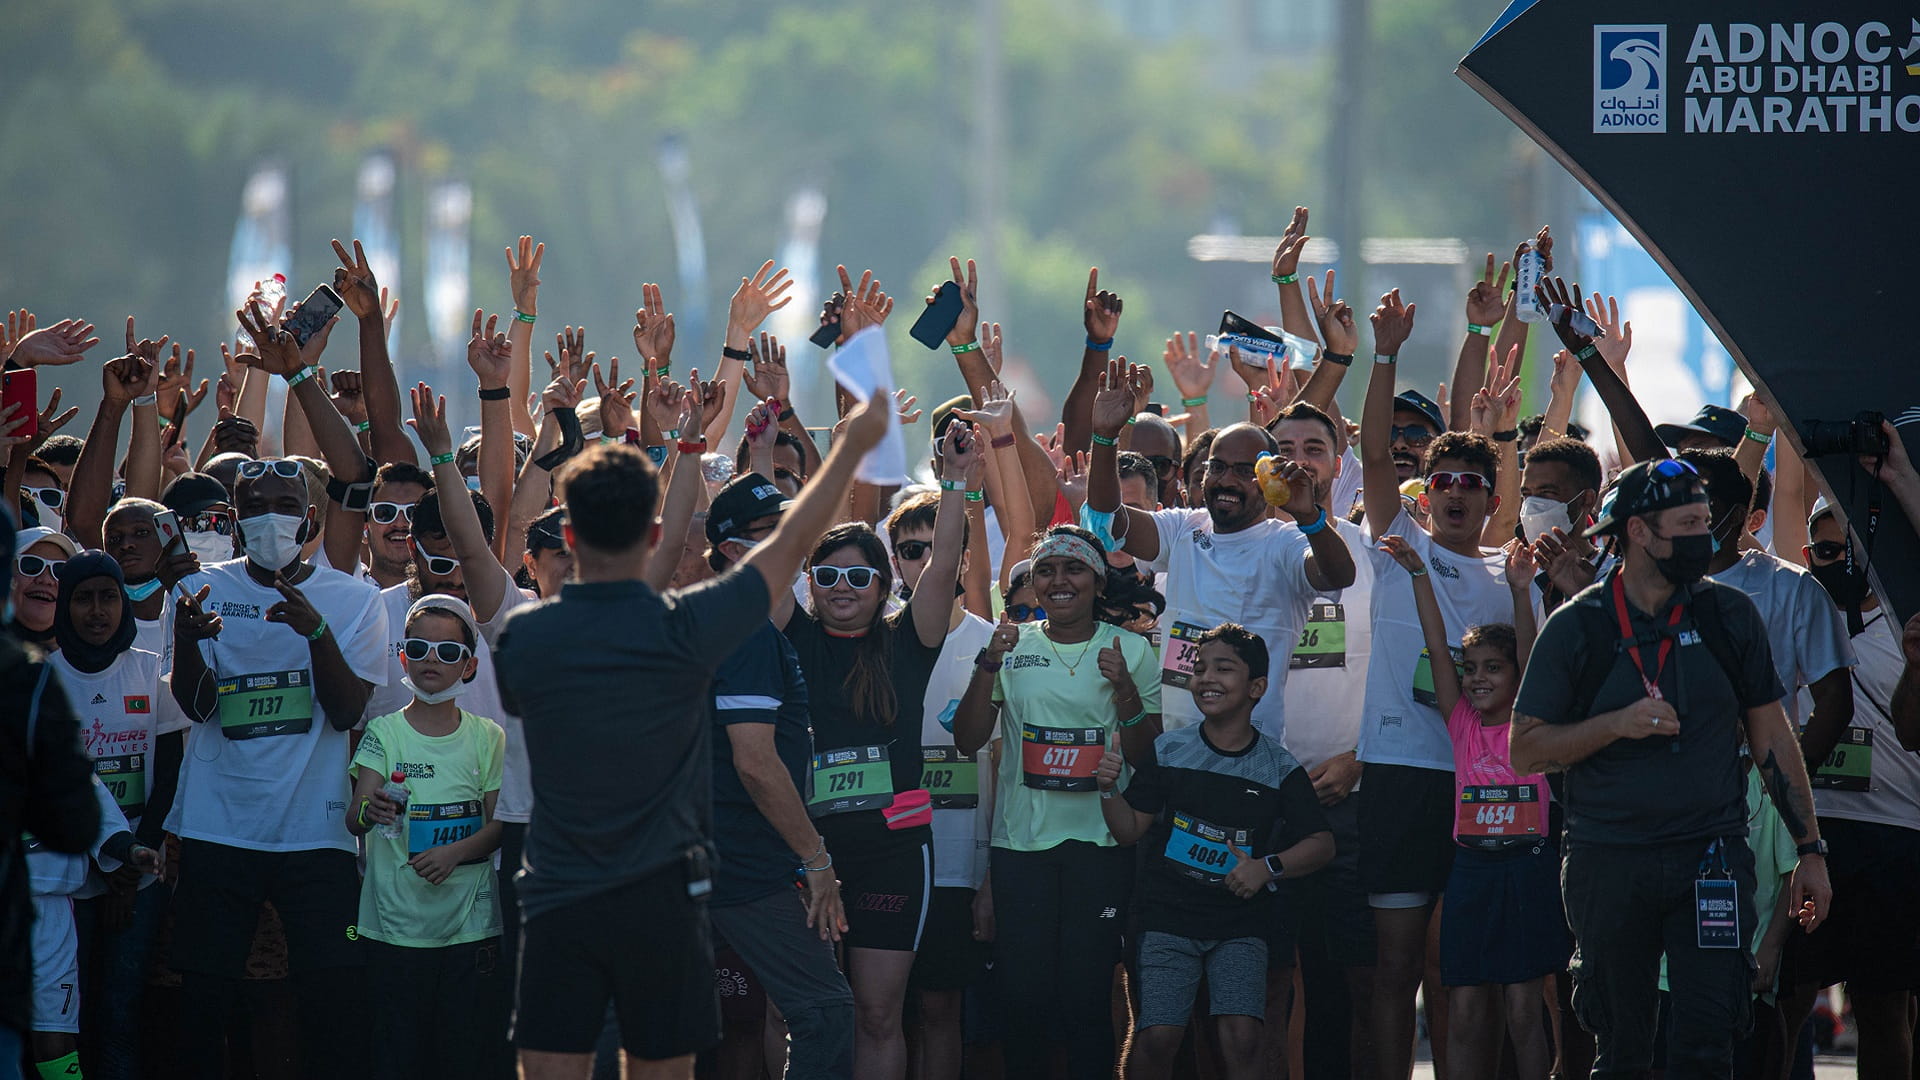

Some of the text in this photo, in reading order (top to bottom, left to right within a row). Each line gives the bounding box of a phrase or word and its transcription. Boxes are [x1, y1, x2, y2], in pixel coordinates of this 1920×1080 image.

[1685, 22, 1892, 64] ADNOC
[1685, 65, 1891, 93] ABU DHABI
[1600, 94, 1660, 112] أدنوك
[1600, 113, 1660, 126] ADNOC
[1685, 95, 1920, 133] MARATHO
[222, 601, 251, 610] ADNOC
[248, 695, 285, 718] 7137
[1042, 747, 1080, 767] 6717
[105, 780, 128, 799] 70
[829, 770, 865, 793] 7291
[1475, 805, 1516, 825] 6654
[857, 893, 909, 913] NIKE
[60, 983, 74, 1016] 7
